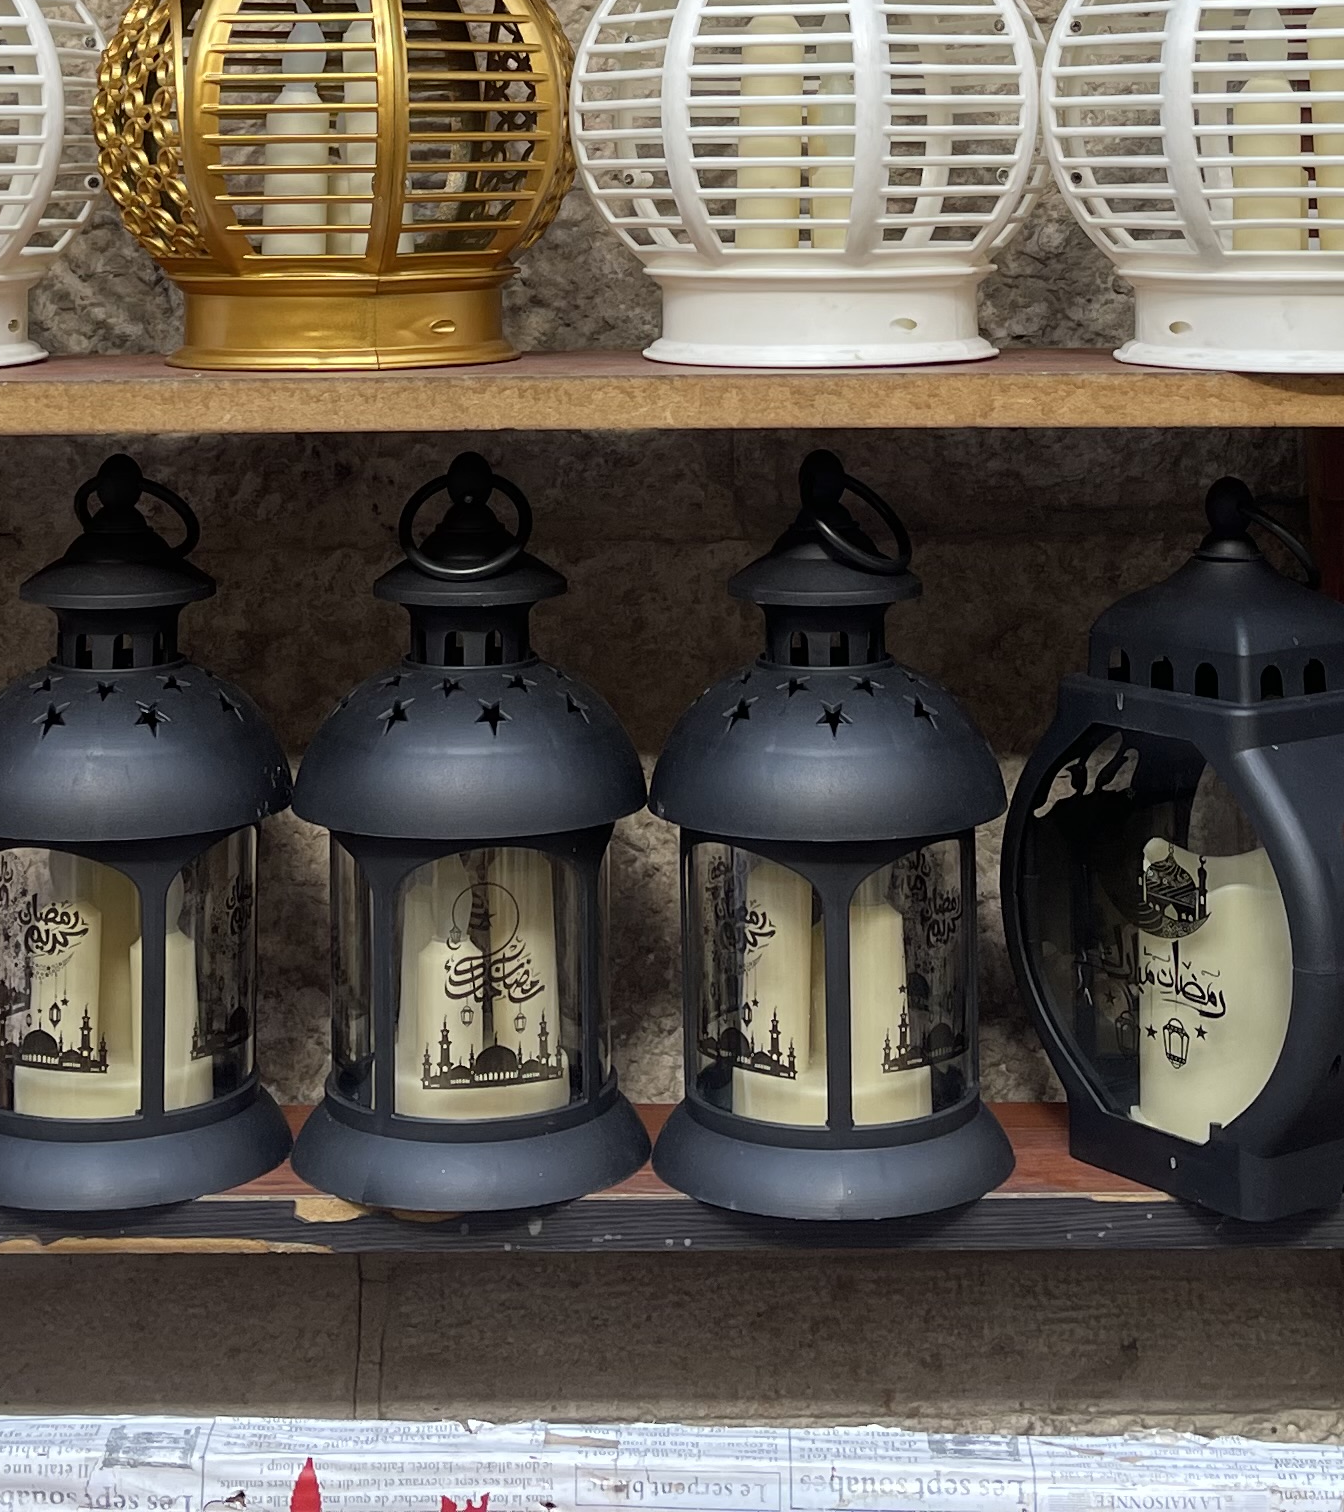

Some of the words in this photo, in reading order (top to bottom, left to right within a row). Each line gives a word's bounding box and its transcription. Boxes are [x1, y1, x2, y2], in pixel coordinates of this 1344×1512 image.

[17, 892, 86, 930] رمضان
[24, 922, 89, 957] كريم
[1157, 939, 1227, 1019] رمضان
[577, 1450, 589, 1459] la
[4, 1464, 32, 1475] une
[37, 1464, 72, 1478] était
[78, 1464, 89, 1478] Il
[267, 1459, 294, 1473] loup
[371, 1462, 405, 1473] Faites
[442, 1462, 453, 1473] la
[515, 1462, 540, 1472] dois
[217, 1478, 263, 1490] enfants,
[338, 1479, 354, 1490] dit
[358, 1478, 381, 1490] leur
[383, 1478, 394, 1488] et
[456, 1476, 473, 1488] sept
[478, 1478, 500, 1487] ses
[504, 1477, 532, 1488] alors
[652, 1477, 733, 1497] serpent
[914, 1471, 971, 1501] sept
[740, 1483, 766, 1503] Le
[800, 1475, 908, 1503] souabes
[979, 1479, 1025, 1504] Les
[84, 1487, 139, 1509] sept
[147, 1495, 192, 1512] Les
[266, 1496, 288, 1506] Elle
[344, 1494, 371, 1505] quoi
[375, 1495, 389, 1506] de
[513, 1495, 522, 1506] la
[526, 1494, 553, 1505] dans
[1200, 1496, 1221, 1510] LA
